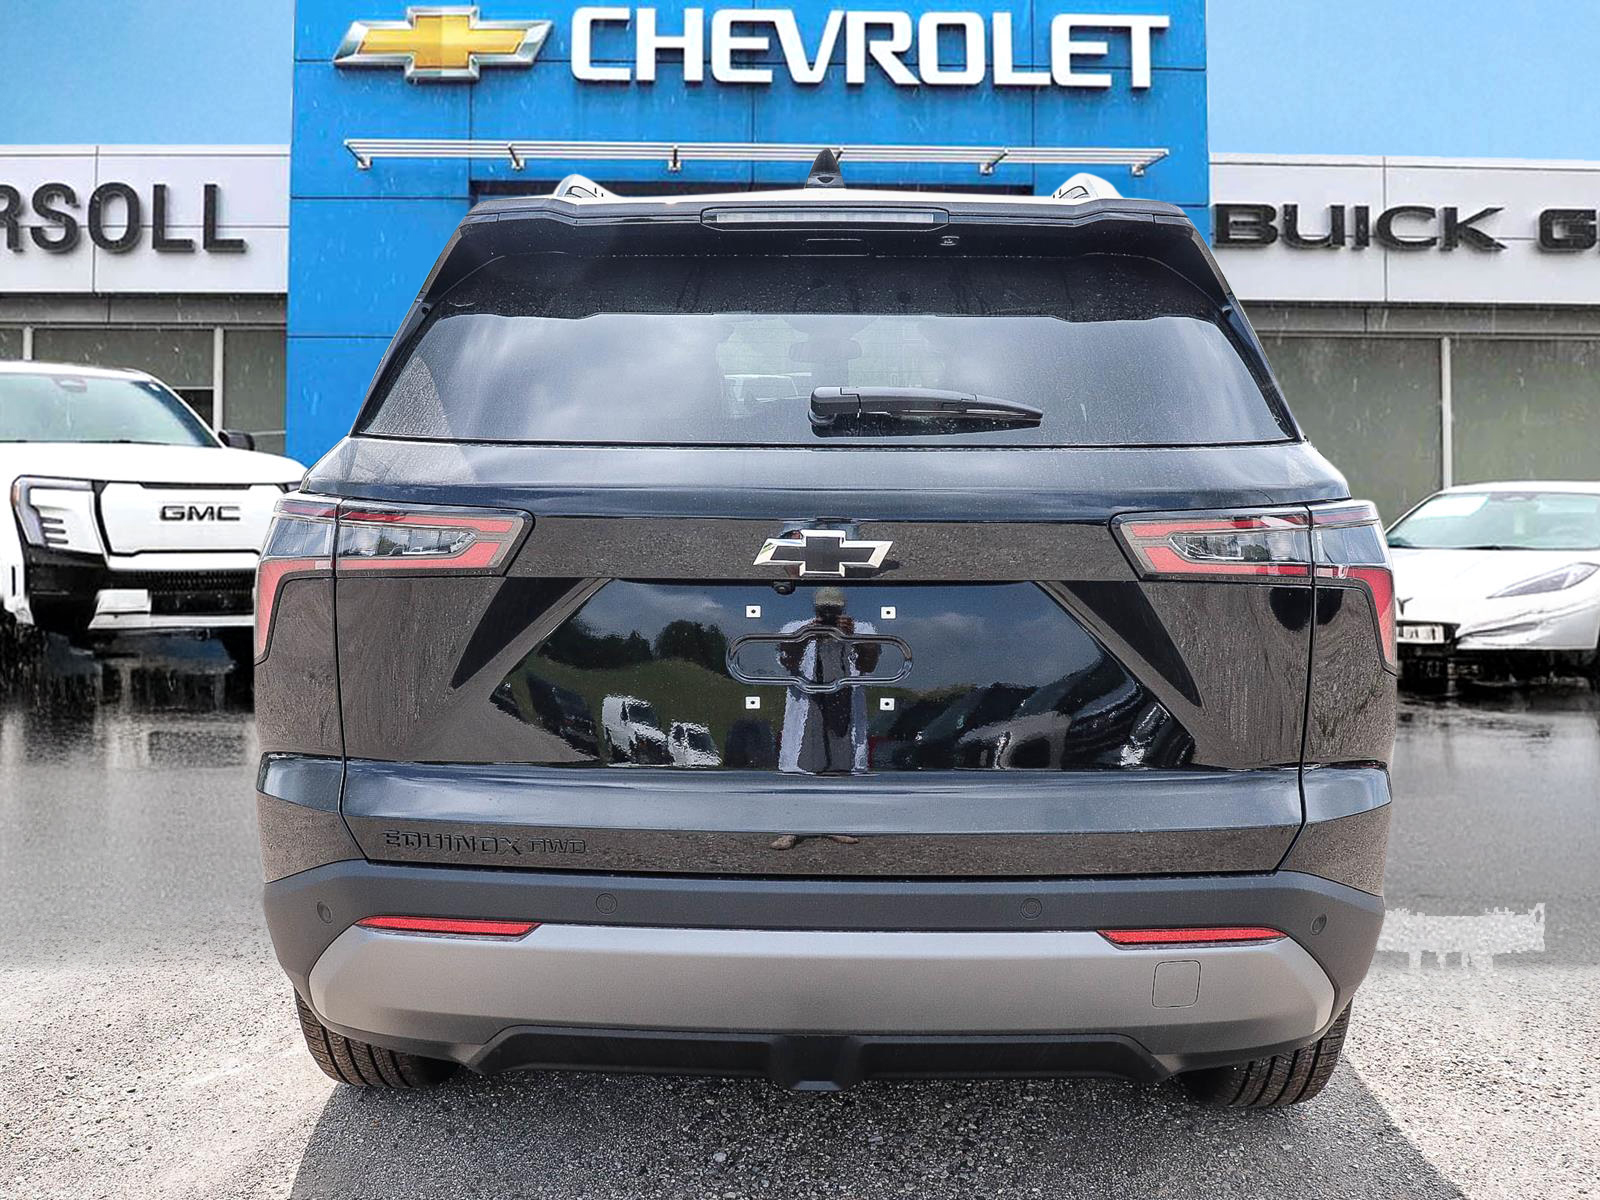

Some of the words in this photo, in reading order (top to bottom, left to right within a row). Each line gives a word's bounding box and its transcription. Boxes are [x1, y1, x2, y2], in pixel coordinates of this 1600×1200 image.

[571, 7, 1170, 88] CHEVROLET
[1213, 203, 1506, 250] BUICK
[160, 505, 241, 521] GMC
[383, 829, 521, 855] EQUINOX
